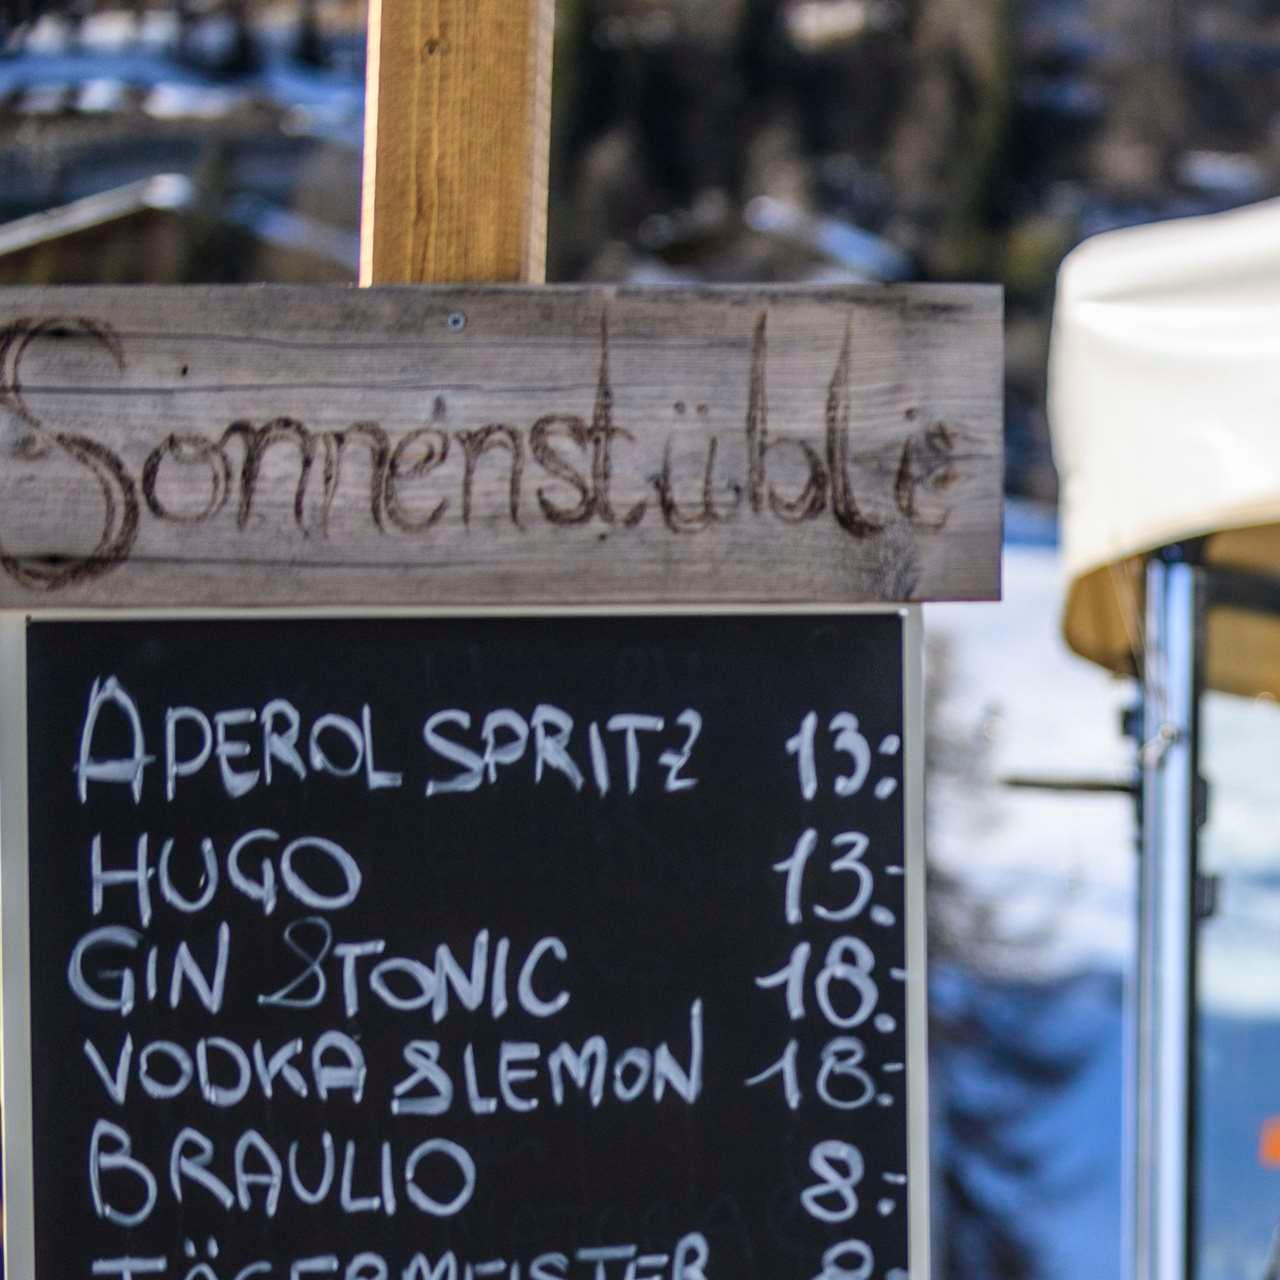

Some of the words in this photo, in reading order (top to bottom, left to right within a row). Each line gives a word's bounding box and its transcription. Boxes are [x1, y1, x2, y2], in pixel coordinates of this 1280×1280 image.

[74, 676, 402, 803] APEROL
[422, 703, 703, 798] SPRITZ
[92, 829, 362, 926] HUGO
[68, 922, 229, 1016] GIN
[84, 1031, 367, 1106] VODKA
[90, 1119, 475, 1225] BRAULIO
